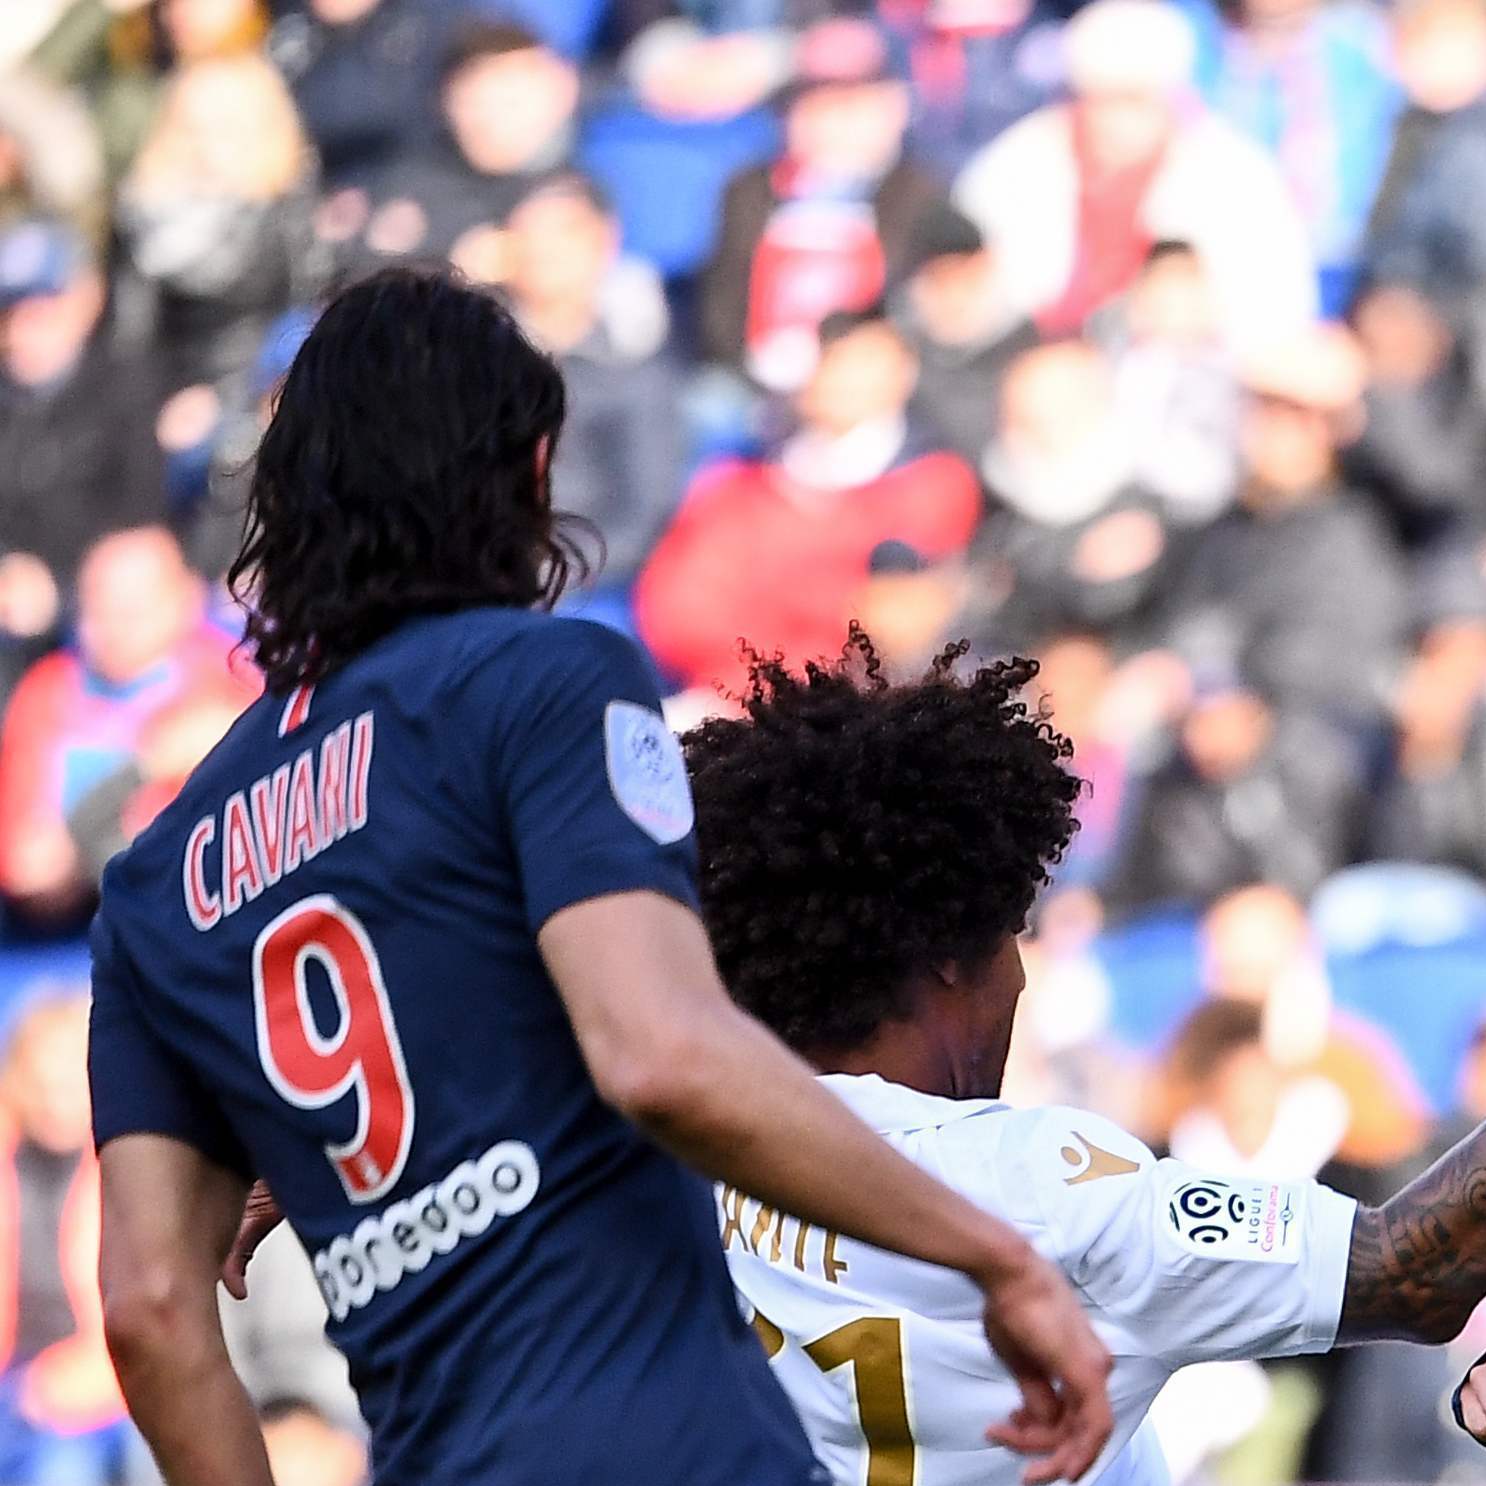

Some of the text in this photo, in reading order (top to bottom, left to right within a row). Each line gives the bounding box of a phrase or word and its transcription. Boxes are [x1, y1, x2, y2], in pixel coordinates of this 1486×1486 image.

[183, 711, 374, 932] CAVANI
[253, 893, 414, 1203] 9
[1248, 1198, 1262, 1244] LIGUE
